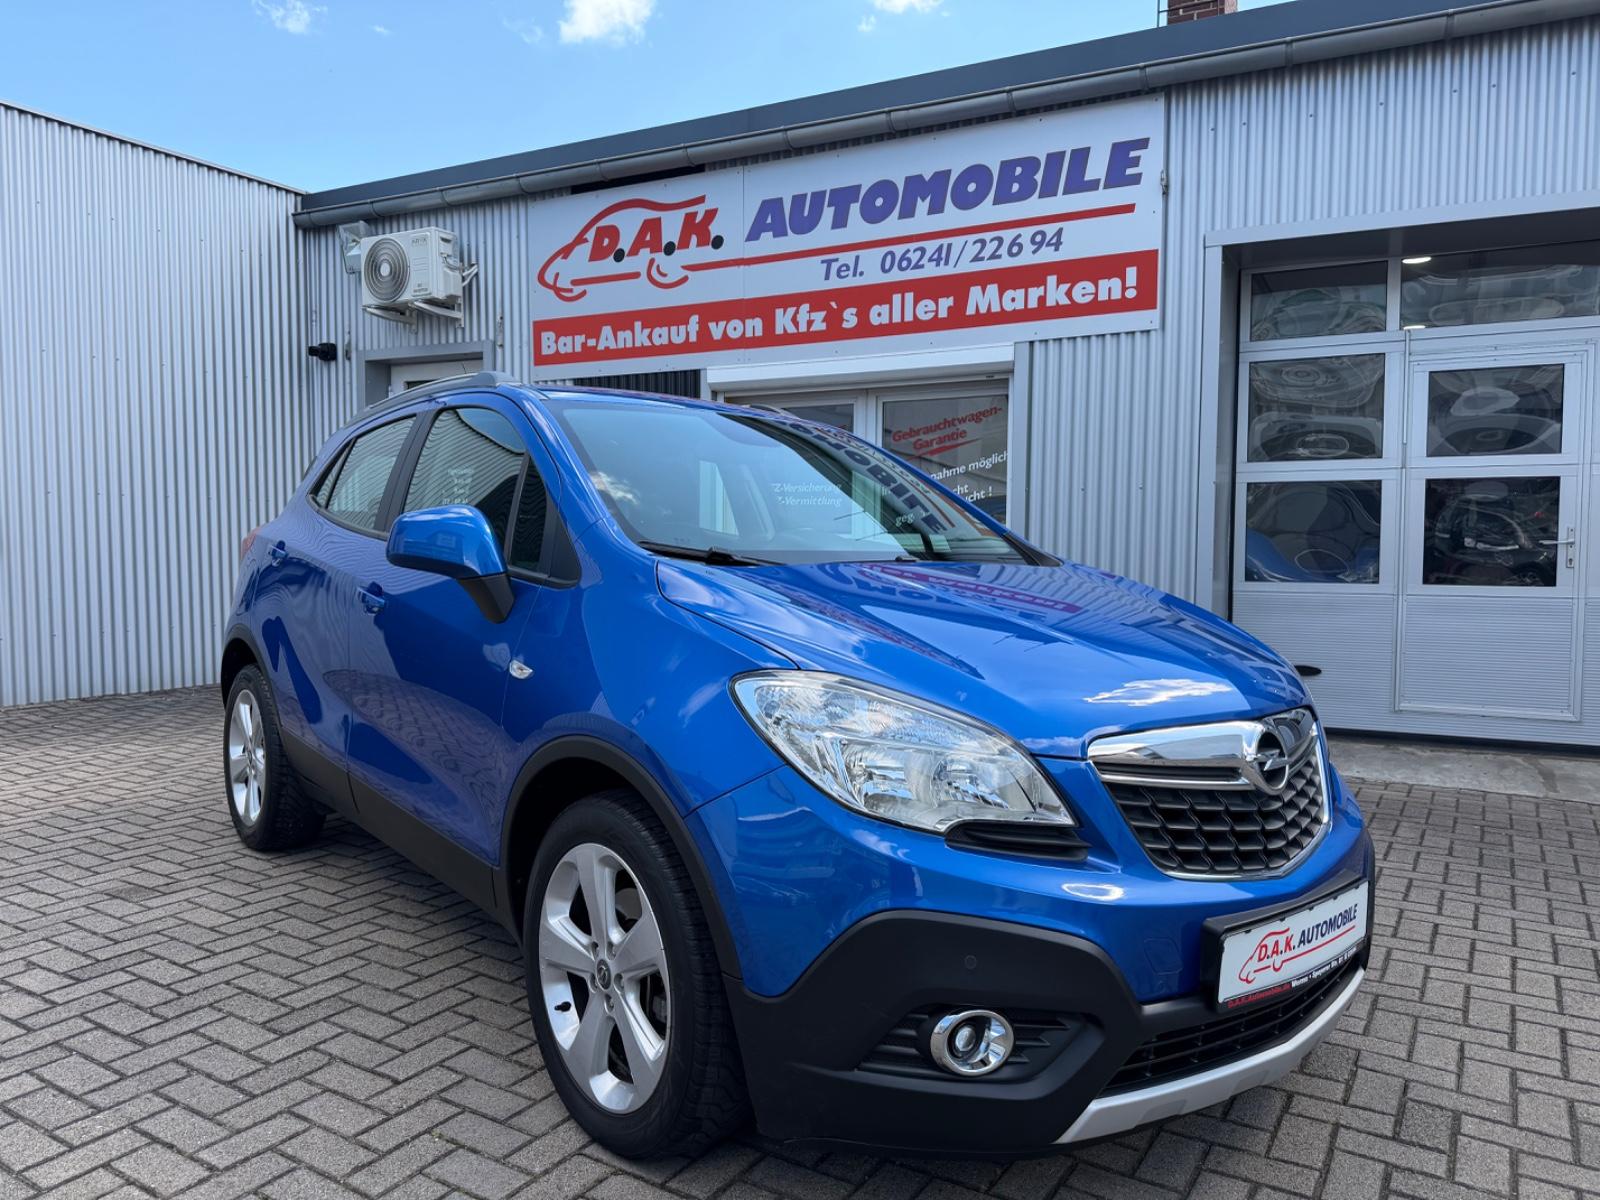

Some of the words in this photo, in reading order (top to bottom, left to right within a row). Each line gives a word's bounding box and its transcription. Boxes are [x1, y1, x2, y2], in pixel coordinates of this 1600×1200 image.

[588, 207, 725, 263] D.A.K.
[744, 137, 1151, 243] AUTOMOBILE
[820, 255, 865, 281] Tel.
[540, 315, 699, 355] Bar-Ankauf
[708, 316, 763, 340] von
[869, 291, 954, 326] aller
[966, 266, 1137, 316] Marken!
[892, 405, 1003, 443] Gebrauchtwagen-
[912, 429, 968, 451] Garantie
[929, 465, 966, 481] nahme
[1257, 933, 1296, 963] D.A.K.
[1297, 903, 1358, 949] AUTOMOBILE
